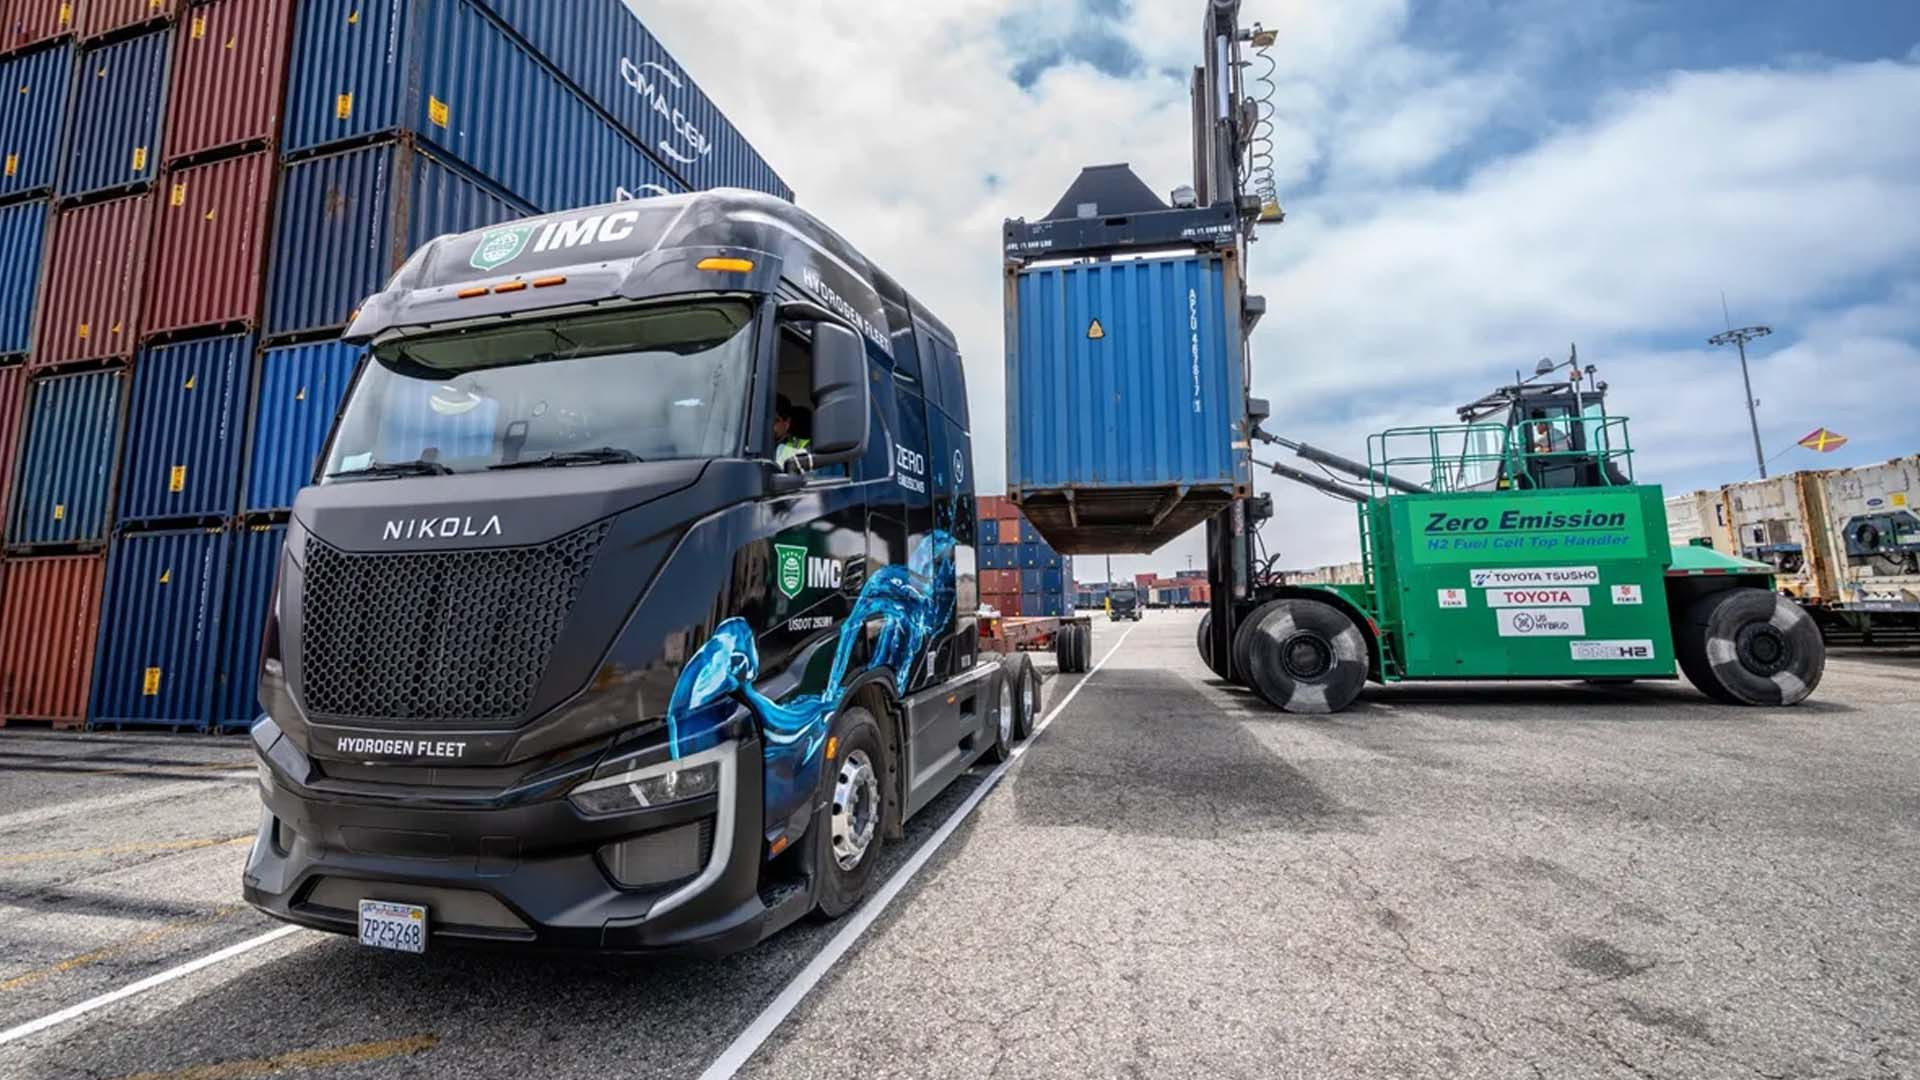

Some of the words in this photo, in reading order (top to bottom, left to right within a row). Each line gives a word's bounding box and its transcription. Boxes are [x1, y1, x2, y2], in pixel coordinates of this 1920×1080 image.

[621, 57, 670, 121] CMA
[672, 108, 712, 163] CGM
[533, 211, 640, 253] IMC
[803, 267, 864, 329] HYDROGEN
[863, 319, 889, 350] FLEET
[1188, 288, 1198, 330] APZU
[895, 443, 925, 476] ZERO
[382, 515, 502, 540] NIKOLA
[1424, 511, 1489, 532] Zero
[1499, 508, 1626, 530] Emission
[1427, 538, 1449, 550] H2
[1453, 537, 1489, 550] Fuel
[1493, 536, 1525, 549] Cell
[1531, 535, 1558, 549] Top
[1563, 533, 1630, 546] Handler
[807, 556, 842, 589] IMC
[1495, 572, 1543, 582] TOYOTA
[1545, 570, 1598, 581] TSUSHO
[1503, 591, 1572, 604] TOYOTA
[1535, 614, 1547, 622] US
[1535, 621, 1570, 631] HYBRID
[337, 737, 414, 755] HYDROGEN
[417, 741, 467, 757] FLEET
[364, 918, 420, 945] ZP25268
